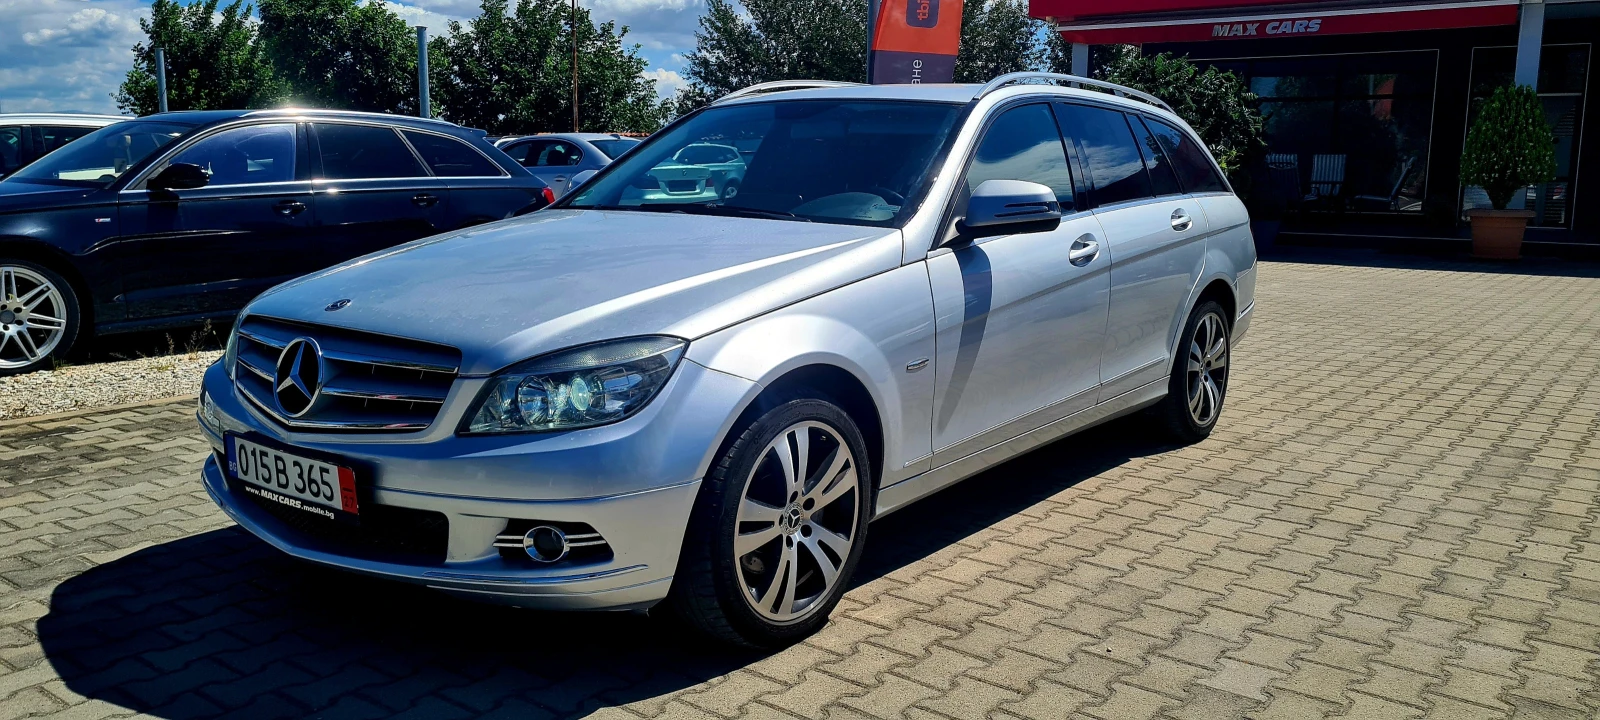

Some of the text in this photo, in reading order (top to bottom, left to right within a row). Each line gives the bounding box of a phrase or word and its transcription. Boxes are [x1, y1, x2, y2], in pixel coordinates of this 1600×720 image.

[1211, 19, 1322, 37] MAX CARS
[228, 460, 237, 472] BG
